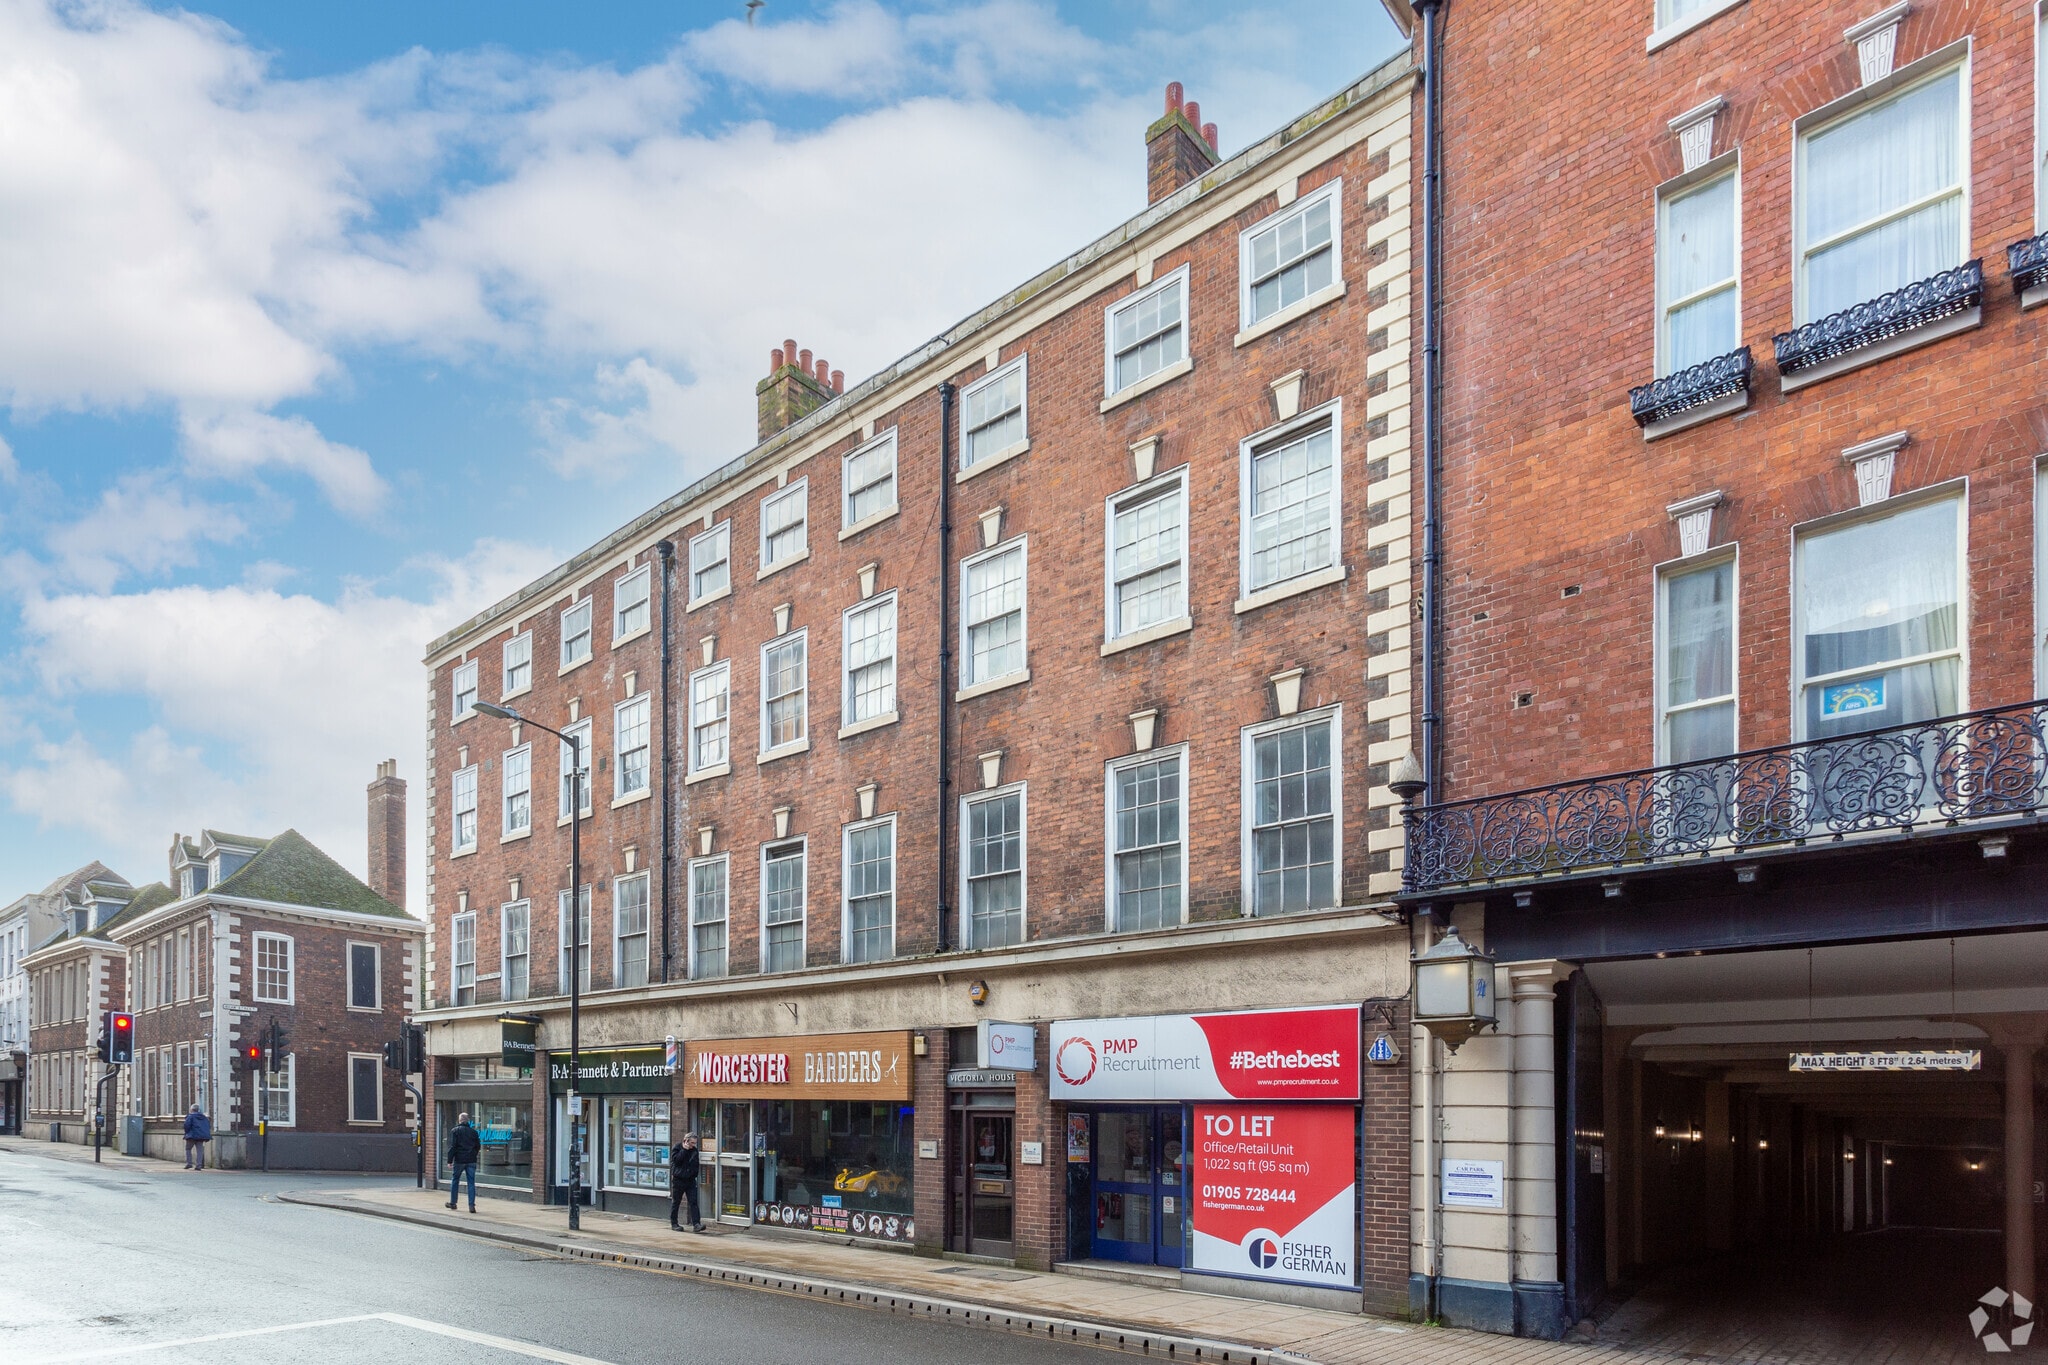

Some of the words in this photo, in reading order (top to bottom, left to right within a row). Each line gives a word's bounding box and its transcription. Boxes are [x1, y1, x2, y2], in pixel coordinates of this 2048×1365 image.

[1103, 1039, 1138, 1054] PMP
[698, 1052, 789, 1084] WORCESTER
[804, 1050, 882, 1083] BARBERS
[1103, 1053, 1201, 1072] Recruitment
[1229, 1049, 1340, 1070] #Bethebest
[1801, 1057, 1825, 1067] MAX
[1829, 1056, 1866, 1067] HEIGHT
[1869, 1057, 1875, 1066] 8
[1907, 1056, 1926, 1066] 2.64
[1929, 1056, 1962, 1066] metres
[611, 1061, 620, 1078] &
[950, 1074, 984, 1082] VICTORIA
[989, 1073, 1016, 1081] HOUSE
[1257, 1078, 1340, 1087] www.pmprecruitment.co.uk
[1203, 1115, 1234, 1136] TO
[1240, 1115, 1275, 1137] LET
[1203, 1141, 1268, 1155] Office/Retail
[1271, 1143, 1294, 1156] Unit
[1203, 1158, 1230, 1171] 1,022
[1233, 1162, 1246, 1173] sq
[1247, 1158, 1256, 1171] ft
[1258, 1159, 1276, 1174] (95
[1279, 1164, 1292, 1175] sq
[1294, 1161, 1310, 1176] m)
[1202, 1185, 1241, 1200] 01905
[1245, 1187, 1296, 1203] 728444
[1203, 1200, 1265, 1212] fishergerman.co.uk
[1282, 1242, 1332, 1260] FISHER
[1282, 1256, 1346, 1276] GERMAN
